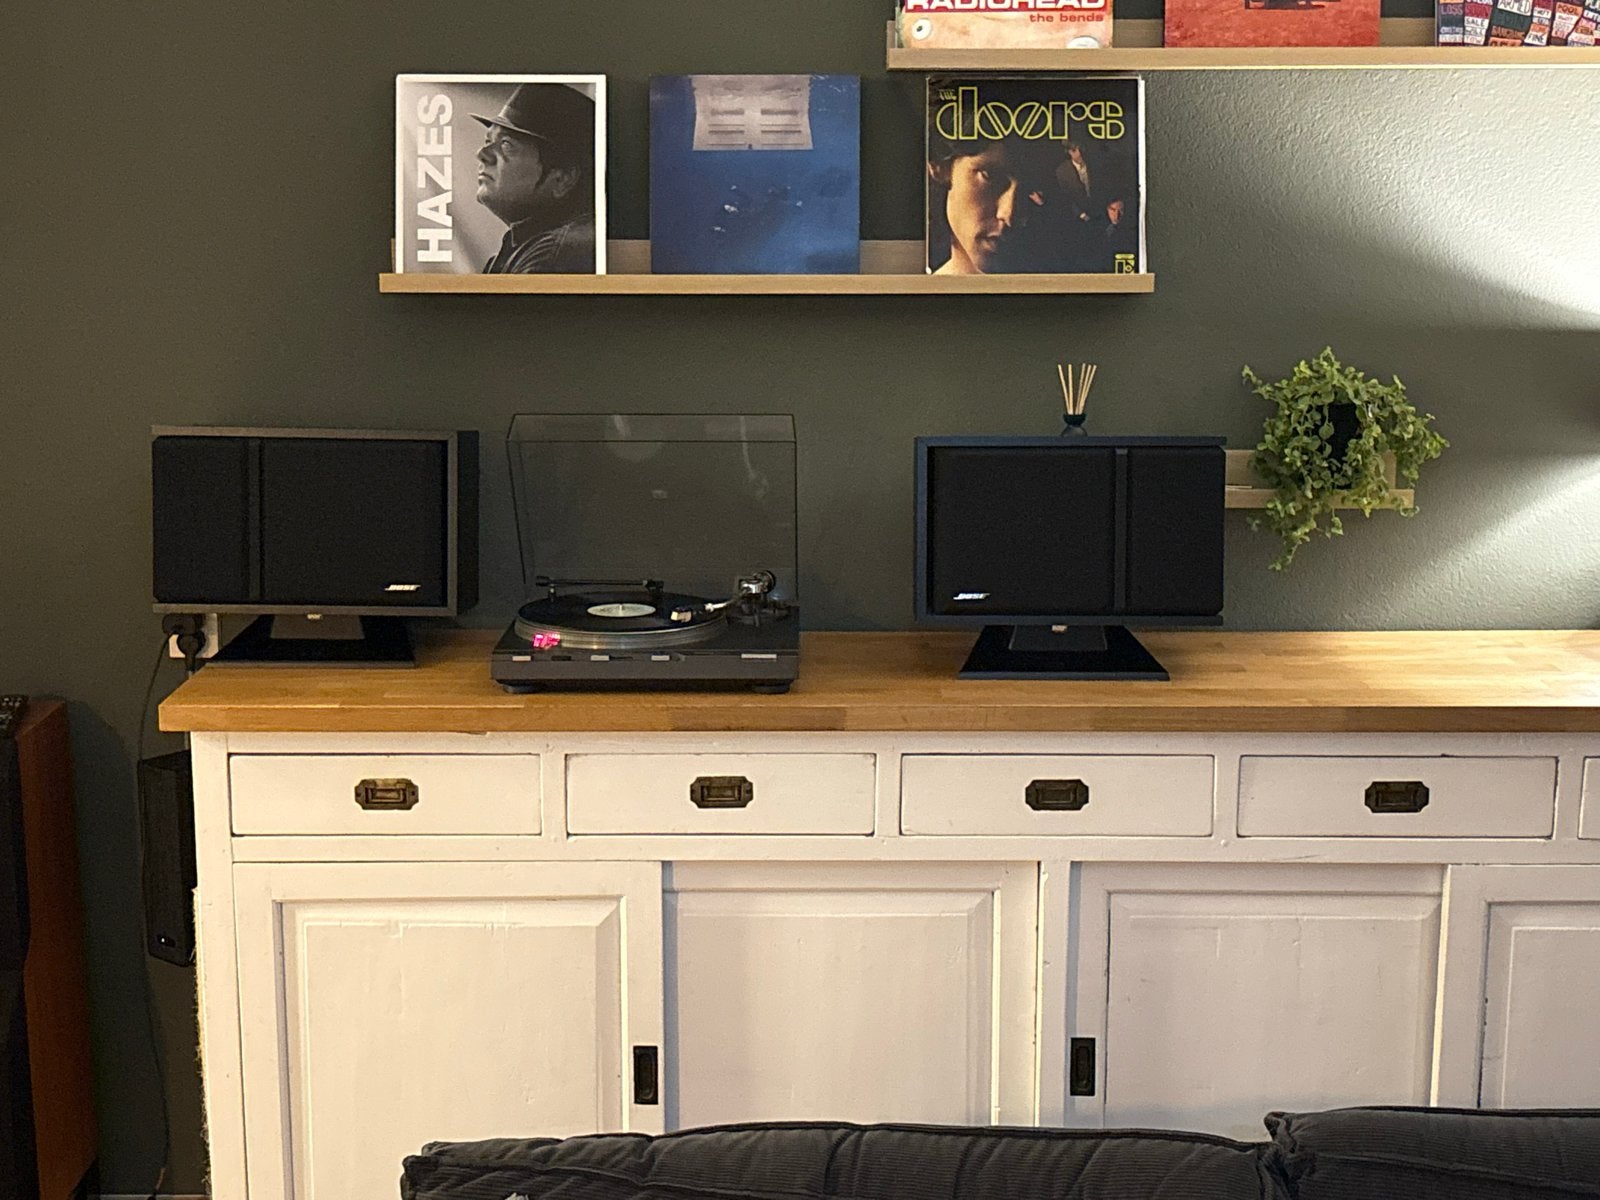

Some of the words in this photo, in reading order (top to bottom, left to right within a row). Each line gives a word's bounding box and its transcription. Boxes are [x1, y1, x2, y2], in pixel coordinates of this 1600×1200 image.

[907, 0, 1105, 9] RADIOHEAD
[1030, 14, 1054, 22] the
[1060, 13, 1104, 22] bends
[1466, 18, 1486, 27] SALE
[417, 94, 453, 262] HAZES
